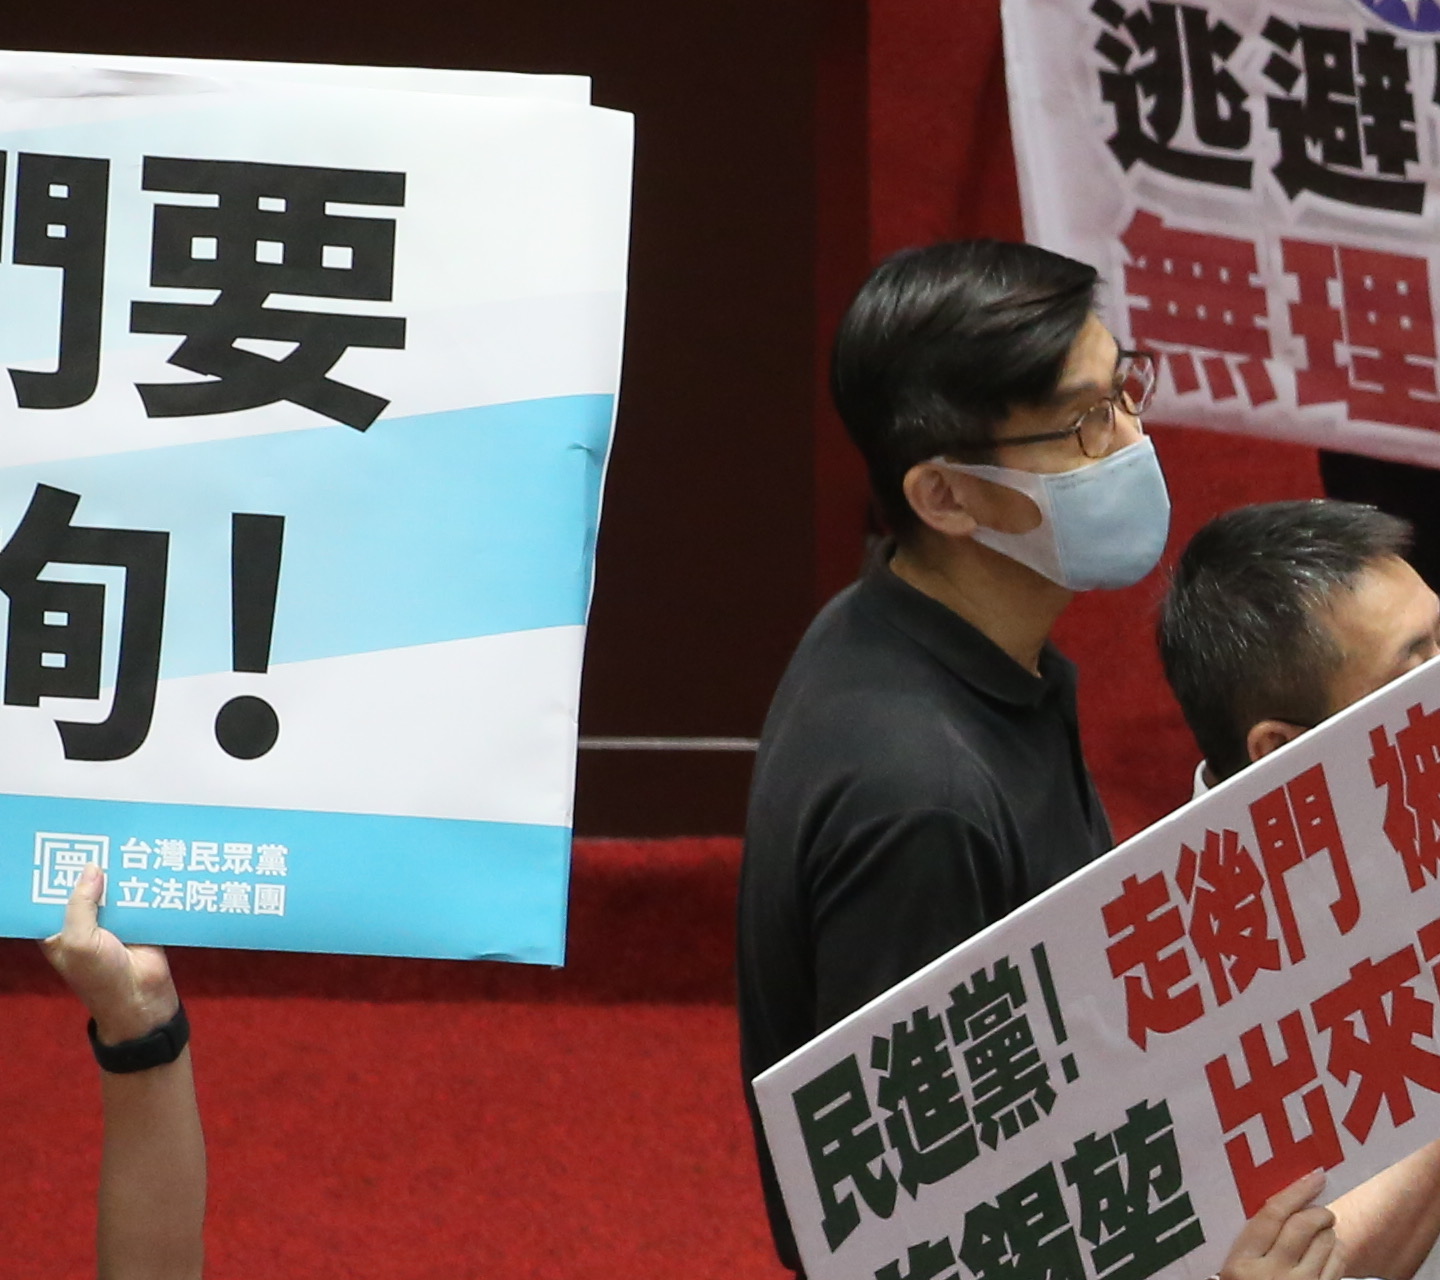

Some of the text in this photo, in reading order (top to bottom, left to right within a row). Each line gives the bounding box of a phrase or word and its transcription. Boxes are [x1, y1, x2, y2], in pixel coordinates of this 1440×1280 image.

[120, 837, 289, 878] 台灣民眾黨
[116, 876, 287, 918] 立法院黨團
[791, 941, 1081, 1253] 民進黨!
[1100, 762, 1364, 1052] 走後門
